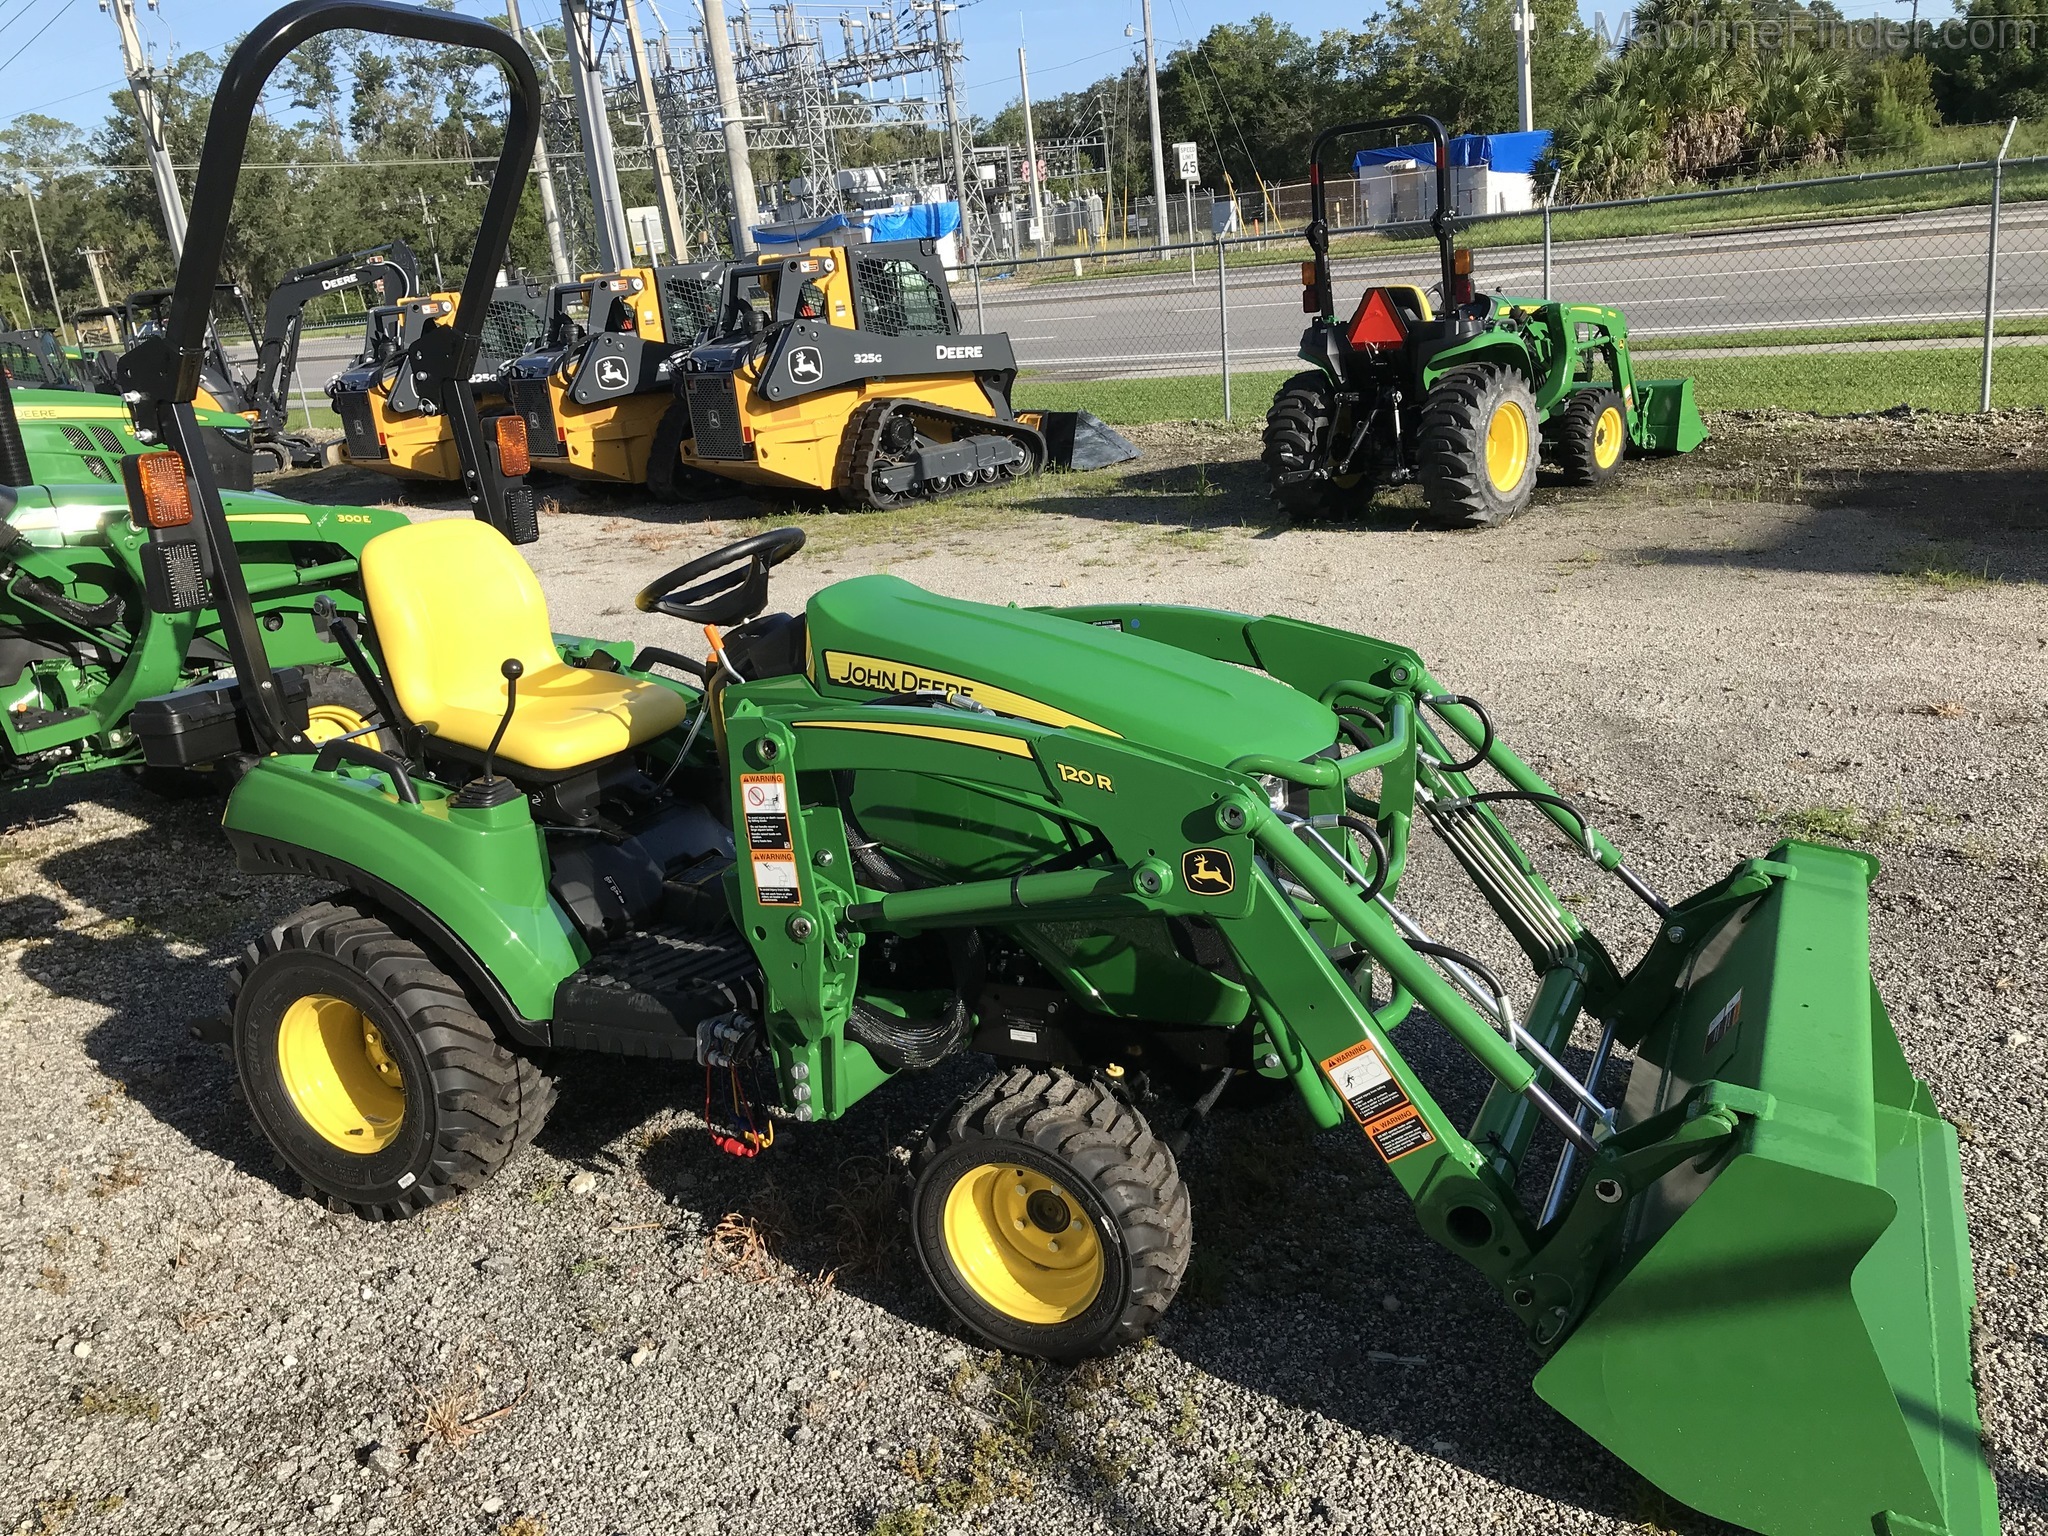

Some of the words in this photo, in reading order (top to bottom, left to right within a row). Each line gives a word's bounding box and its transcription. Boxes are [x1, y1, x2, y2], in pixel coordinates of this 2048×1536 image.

[1181, 161, 1197, 174] 45
[321, 273, 359, 290] DEERE
[853, 353, 882, 363] 325G
[935, 345, 983, 360] DEERE
[840, 661, 896, 689] JOHN
[1335, 1044, 1367, 1063] WARNING
[1380, 1110, 1412, 1129] WARNING
